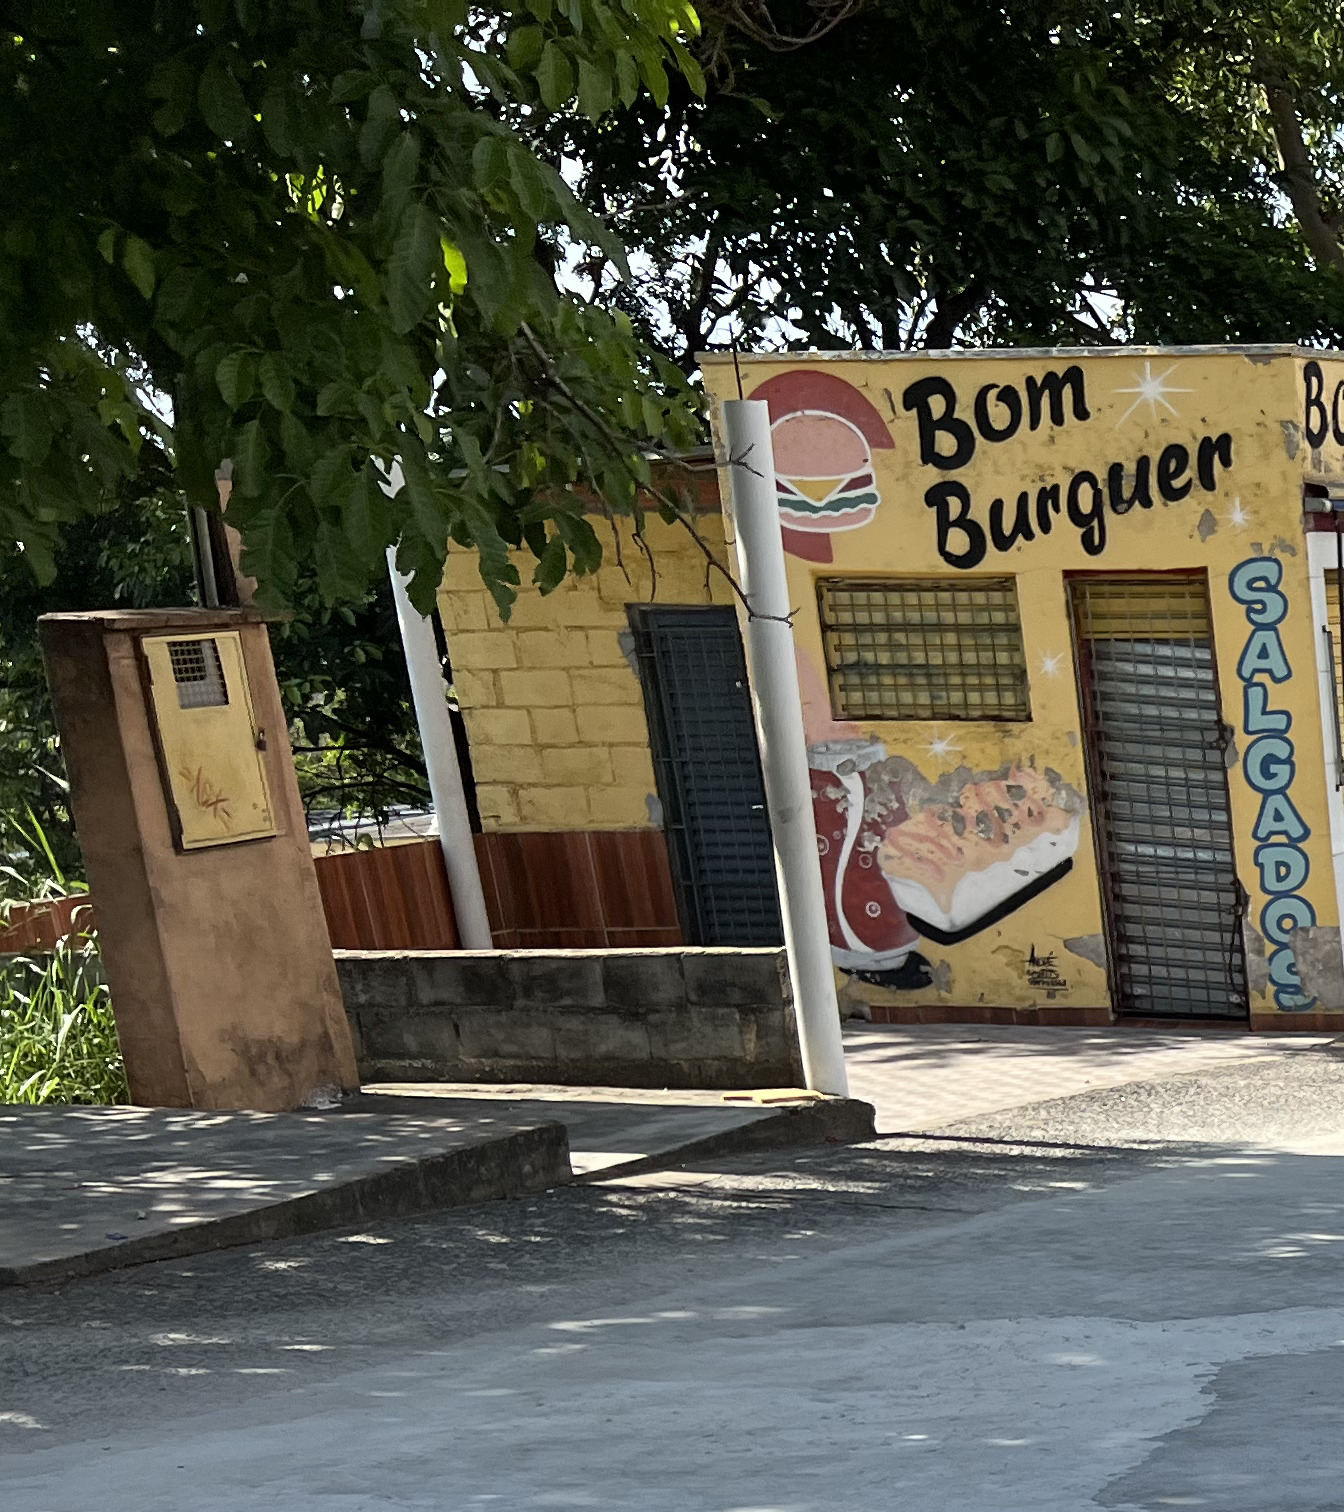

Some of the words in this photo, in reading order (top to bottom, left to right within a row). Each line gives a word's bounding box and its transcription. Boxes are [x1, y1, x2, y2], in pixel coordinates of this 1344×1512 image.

[903, 365, 1091, 471] Bom
[924, 432, 1234, 569] Burguer
[1228, 556, 1317, 1012] SALGADOS
